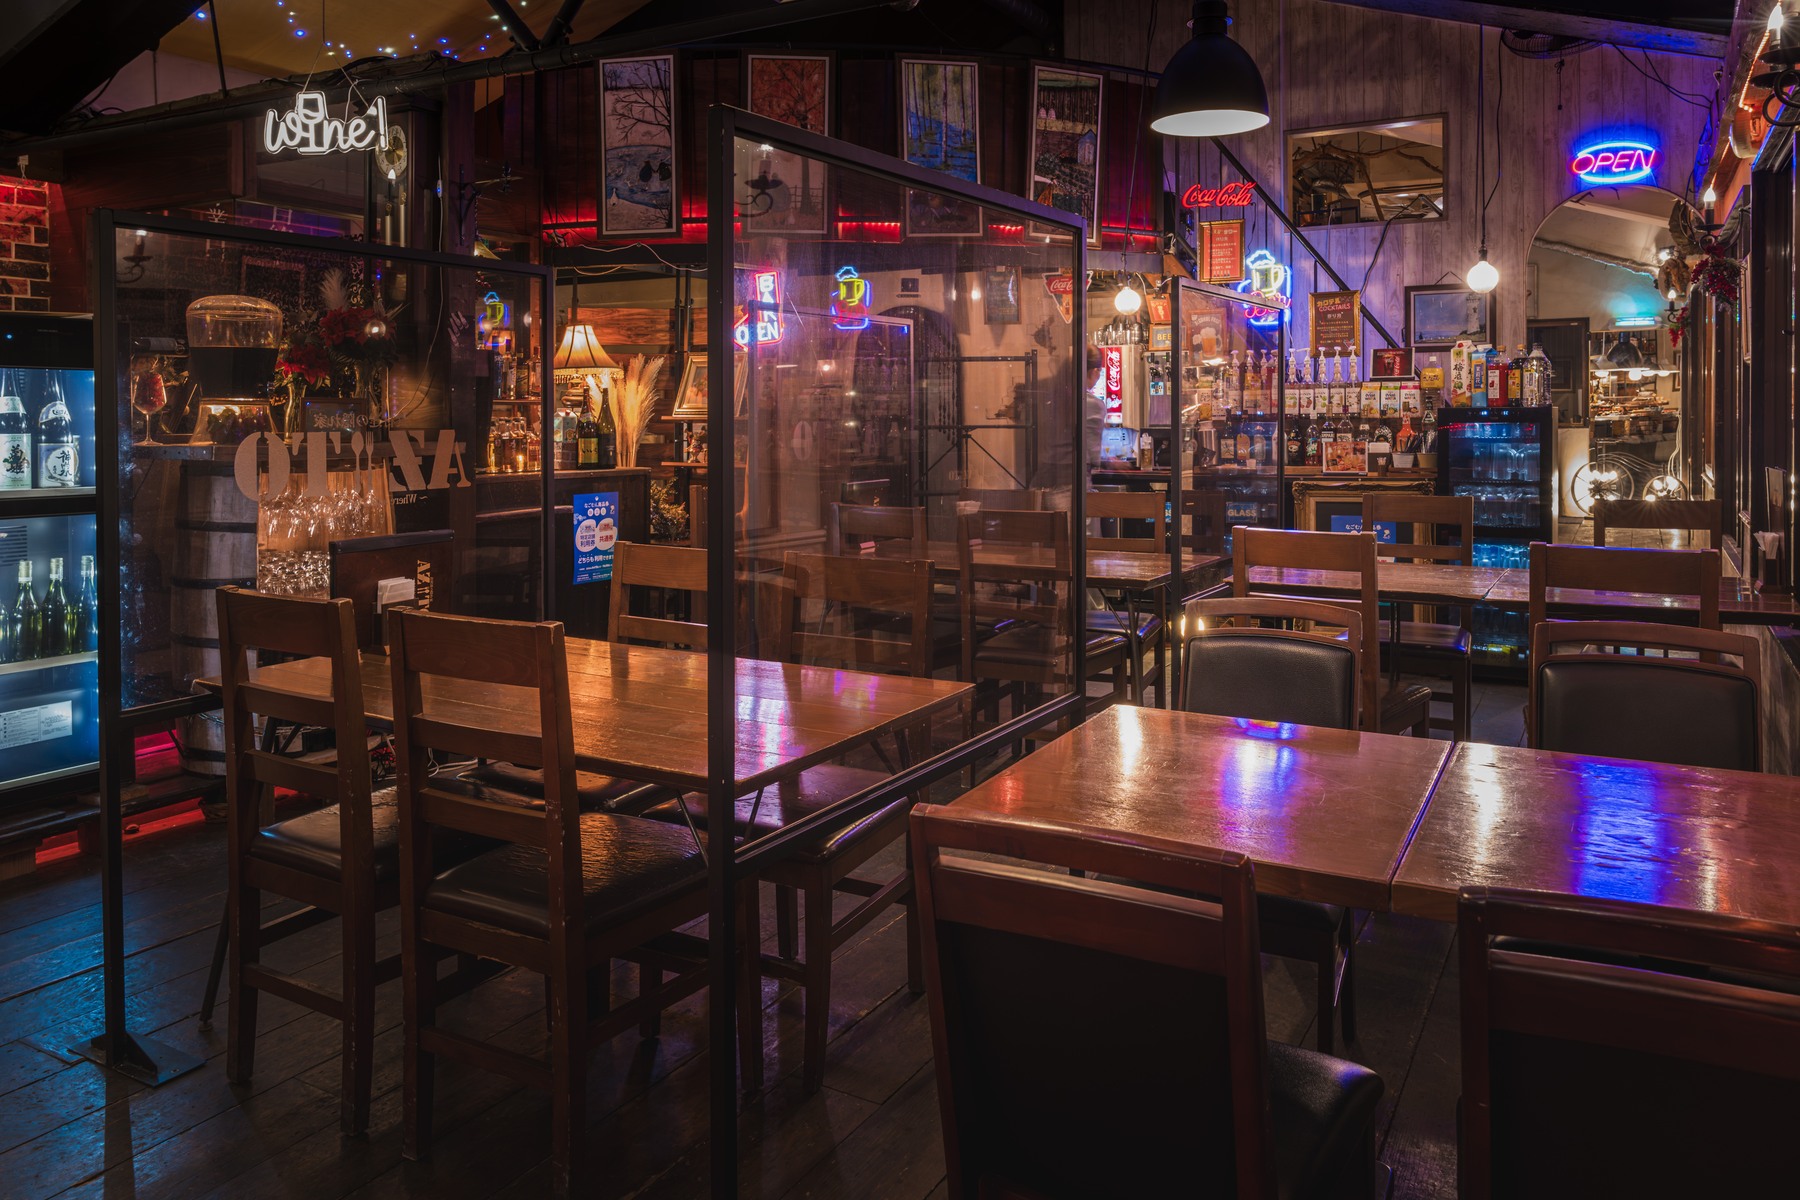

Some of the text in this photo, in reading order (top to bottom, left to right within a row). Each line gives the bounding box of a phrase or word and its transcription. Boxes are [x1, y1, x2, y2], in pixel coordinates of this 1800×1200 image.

[1572, 149, 1656, 174] OPEN
[1181, 182, 1255, 208] Coca-Cola
[758, 275, 778, 322] BAR
[1318, 303, 1351, 312] COCKTAILS
[735, 321, 779, 344] OEN
[1107, 349, 1121, 391] Coca-Cola
[1228, 509, 1257, 517] GLASS
[599, 535, 613, 543] 共通券
